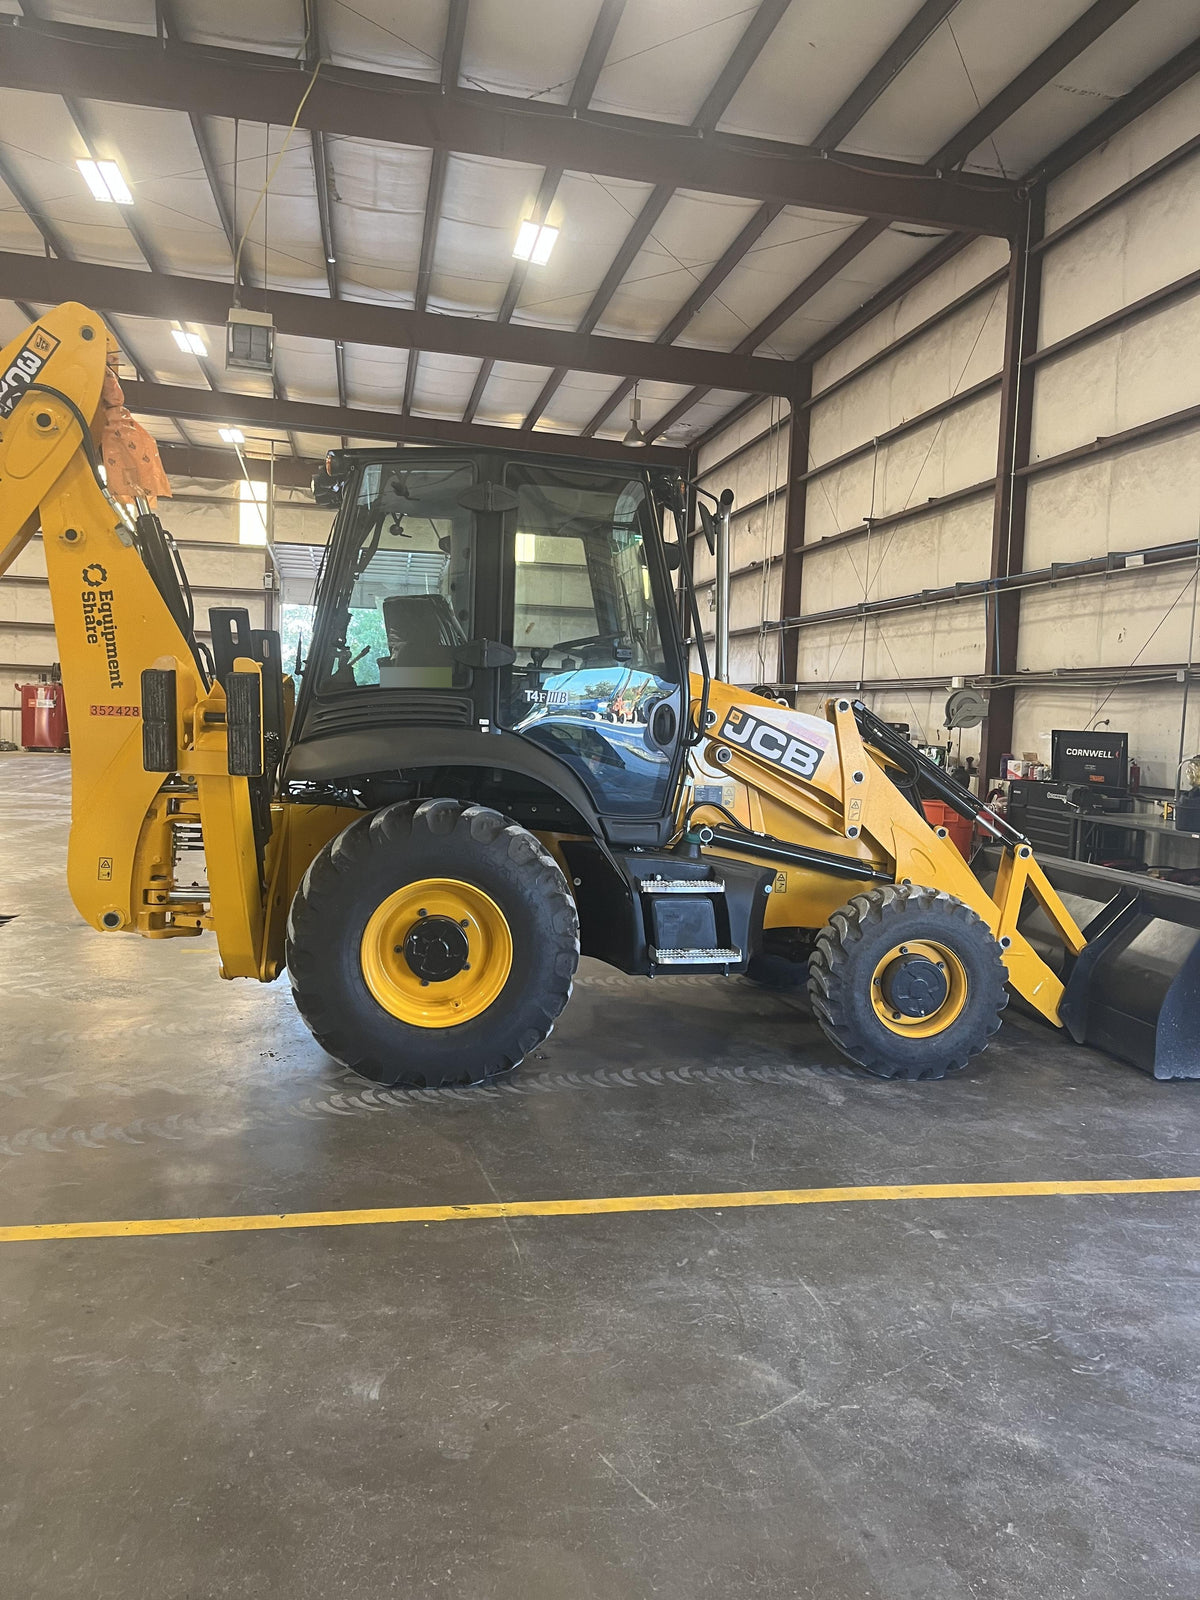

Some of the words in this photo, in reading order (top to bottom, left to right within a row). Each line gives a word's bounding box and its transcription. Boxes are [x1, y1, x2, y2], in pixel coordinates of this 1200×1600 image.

[81, 590, 99, 645] Share
[98, 590, 124, 689] Equipment
[90, 705, 140, 717] 352428
[723, 717, 819, 776] JCB
[1066, 747, 1113, 759] CORNWELL
